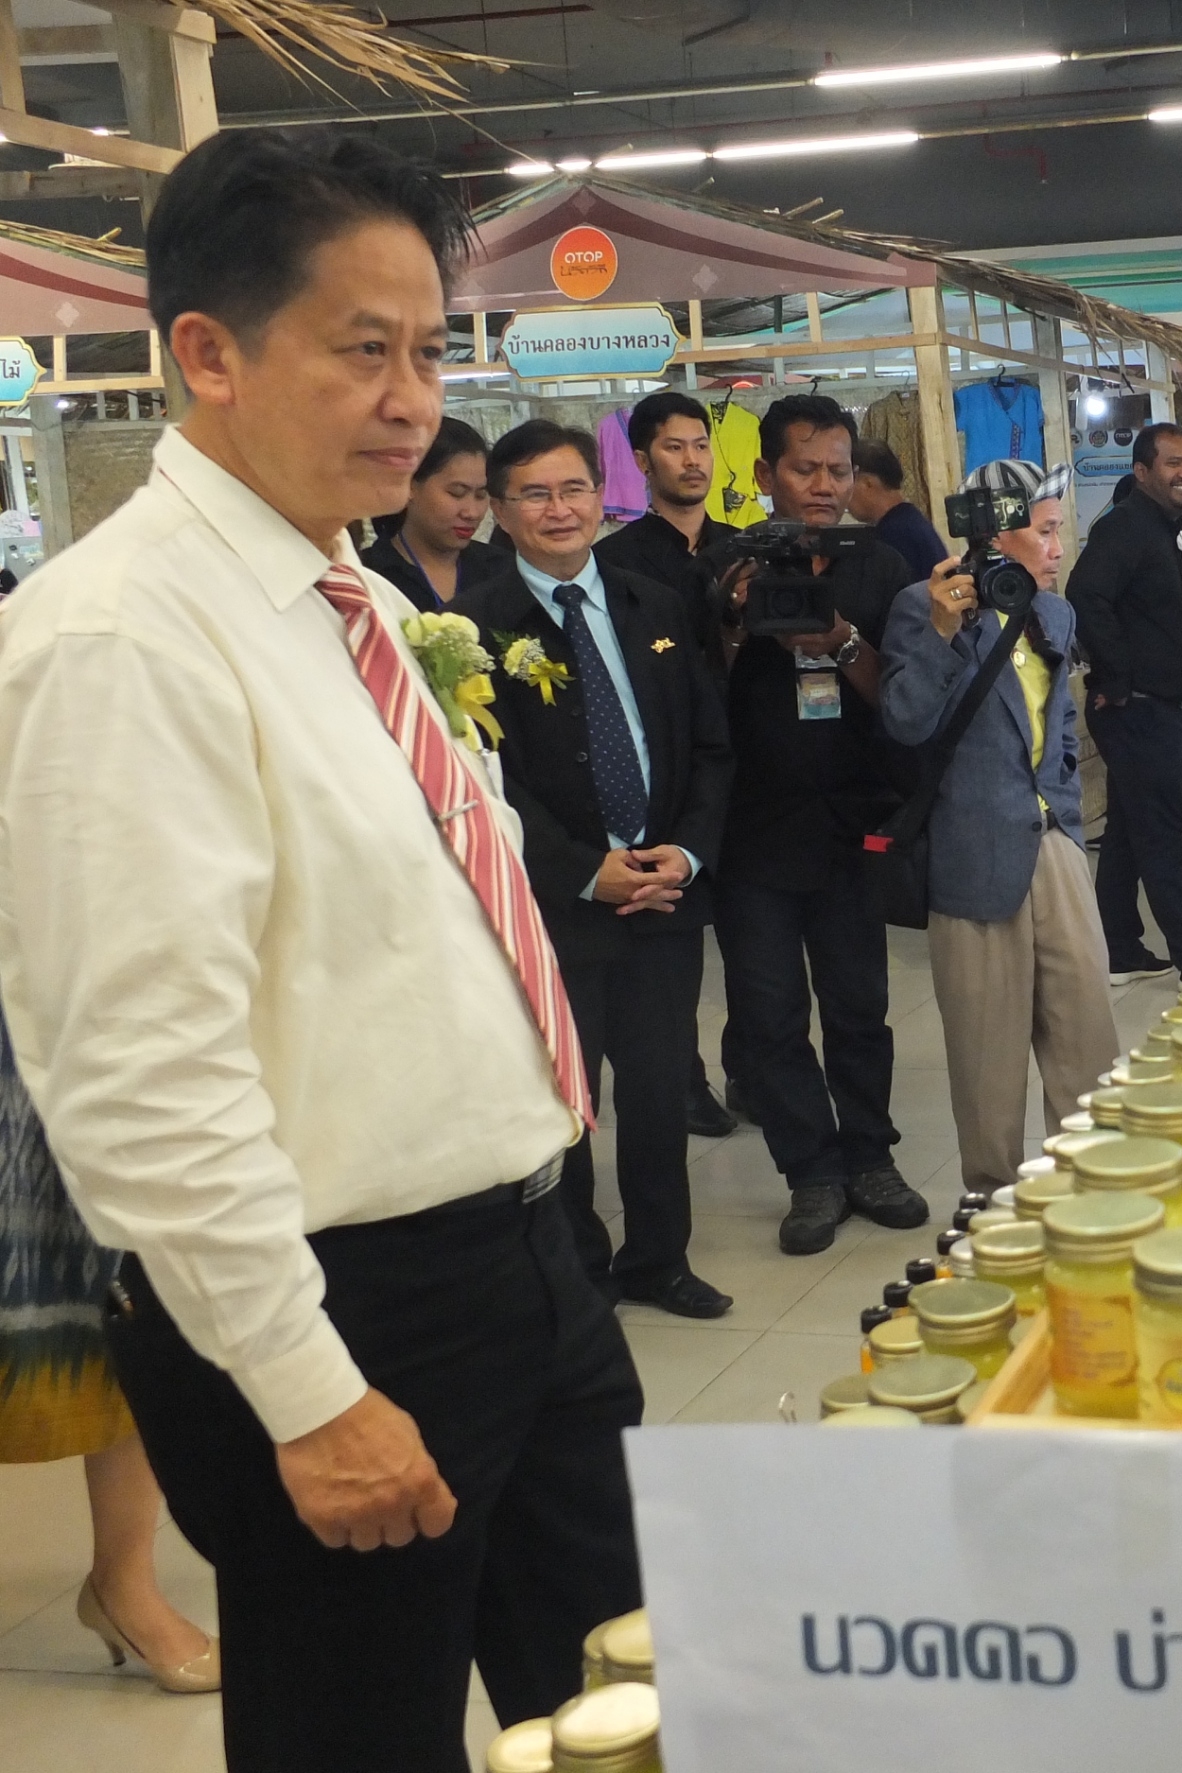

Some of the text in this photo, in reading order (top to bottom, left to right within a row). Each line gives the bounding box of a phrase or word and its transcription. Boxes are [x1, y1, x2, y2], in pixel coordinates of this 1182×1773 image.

[564, 251, 604, 263] OTOP
[507, 333, 670, 354] บ้านคลองบางหลวง
